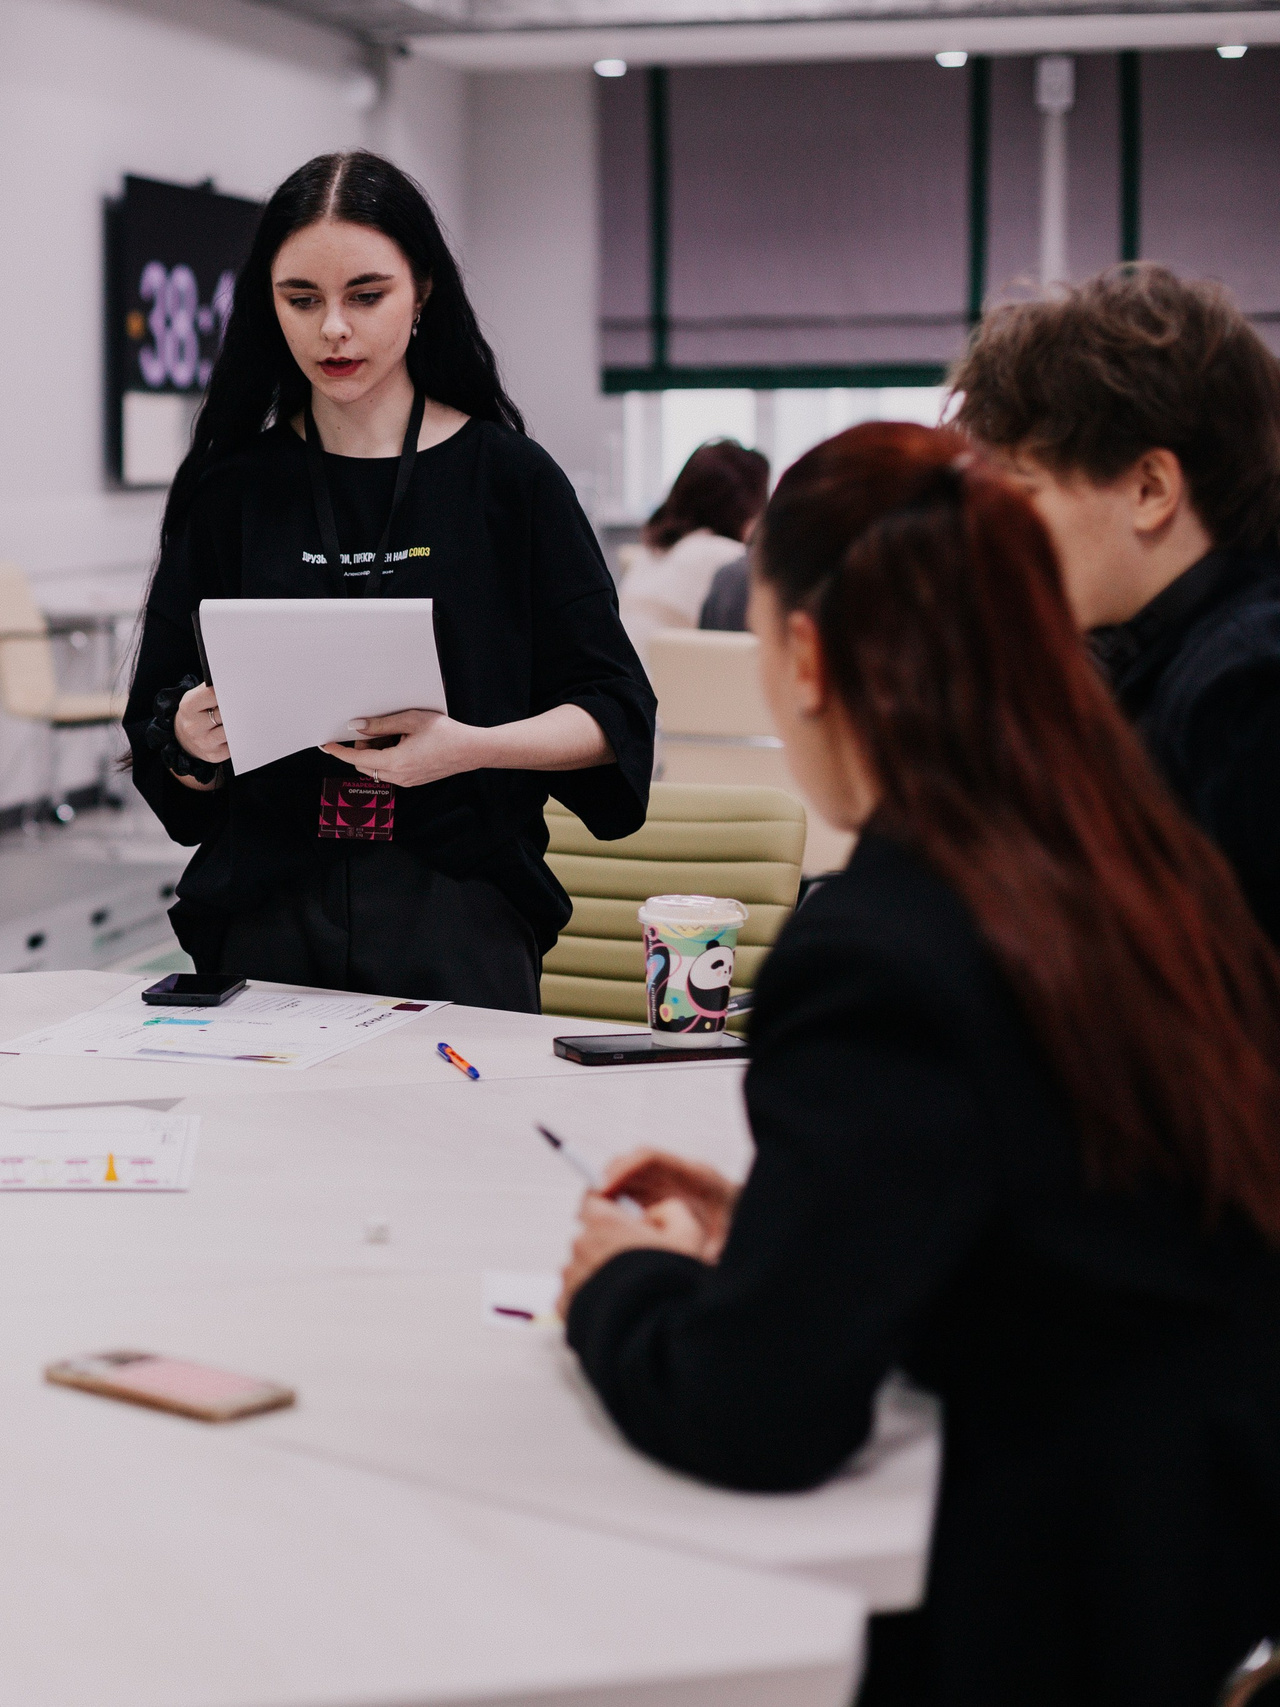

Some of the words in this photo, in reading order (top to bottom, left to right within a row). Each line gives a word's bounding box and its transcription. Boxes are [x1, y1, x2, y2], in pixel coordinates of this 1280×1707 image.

[302, 551, 328, 565] ДРУЗЬ
[393, 549, 409, 562] НАШ
[408, 546, 431, 558] СОЮЗ
